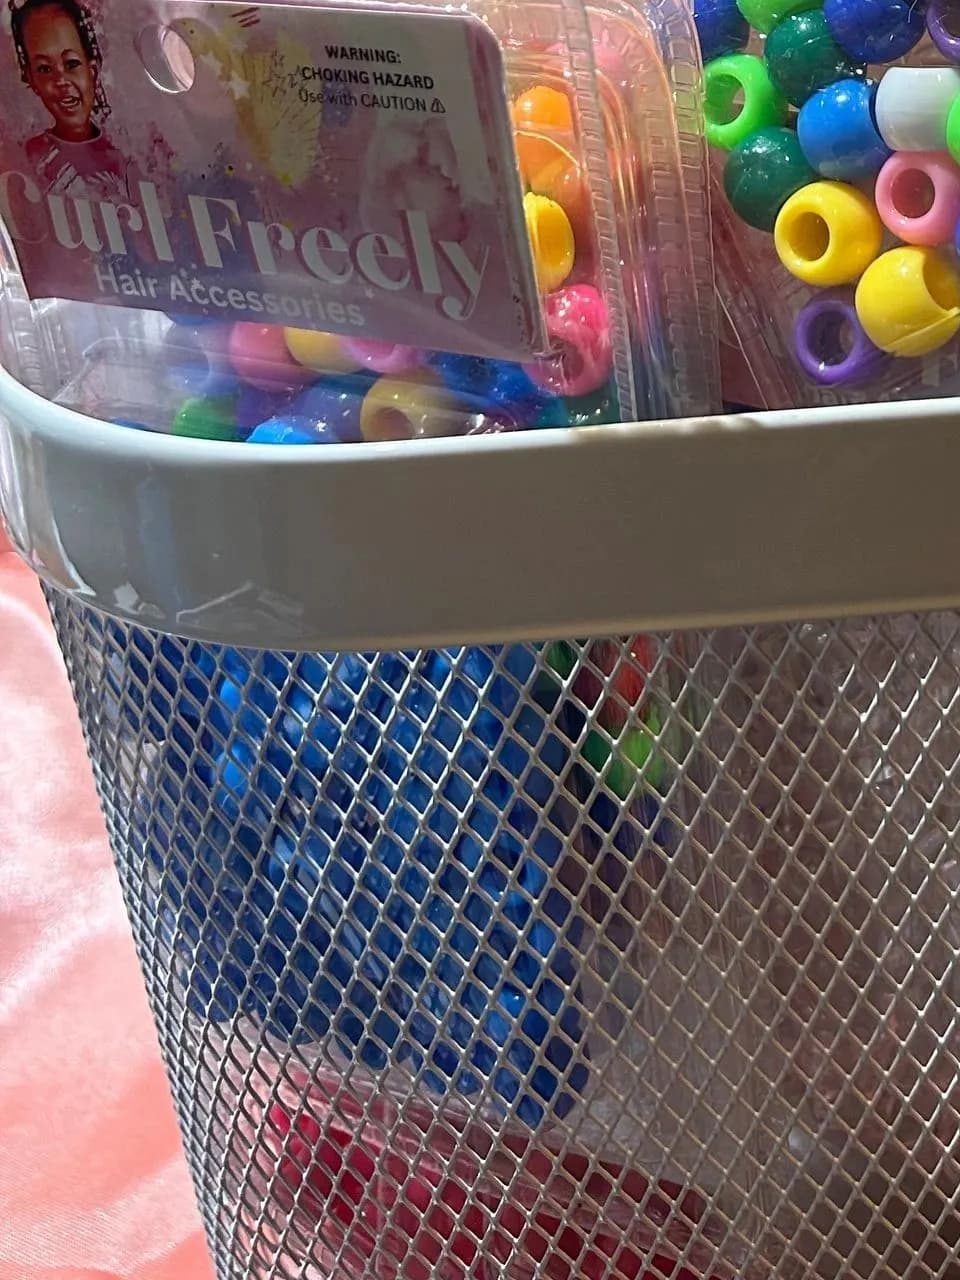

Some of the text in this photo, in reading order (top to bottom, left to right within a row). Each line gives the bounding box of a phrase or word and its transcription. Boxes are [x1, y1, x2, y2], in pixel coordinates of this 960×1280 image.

[324, 45, 402, 64] WARNING:
[302, 66, 435, 90] CHOKING HAZARD
[299, 88, 427, 113] Use with CAUTION
[3, 170, 492, 321] Curl Freely
[94, 262, 366, 327] Hair Accessories
